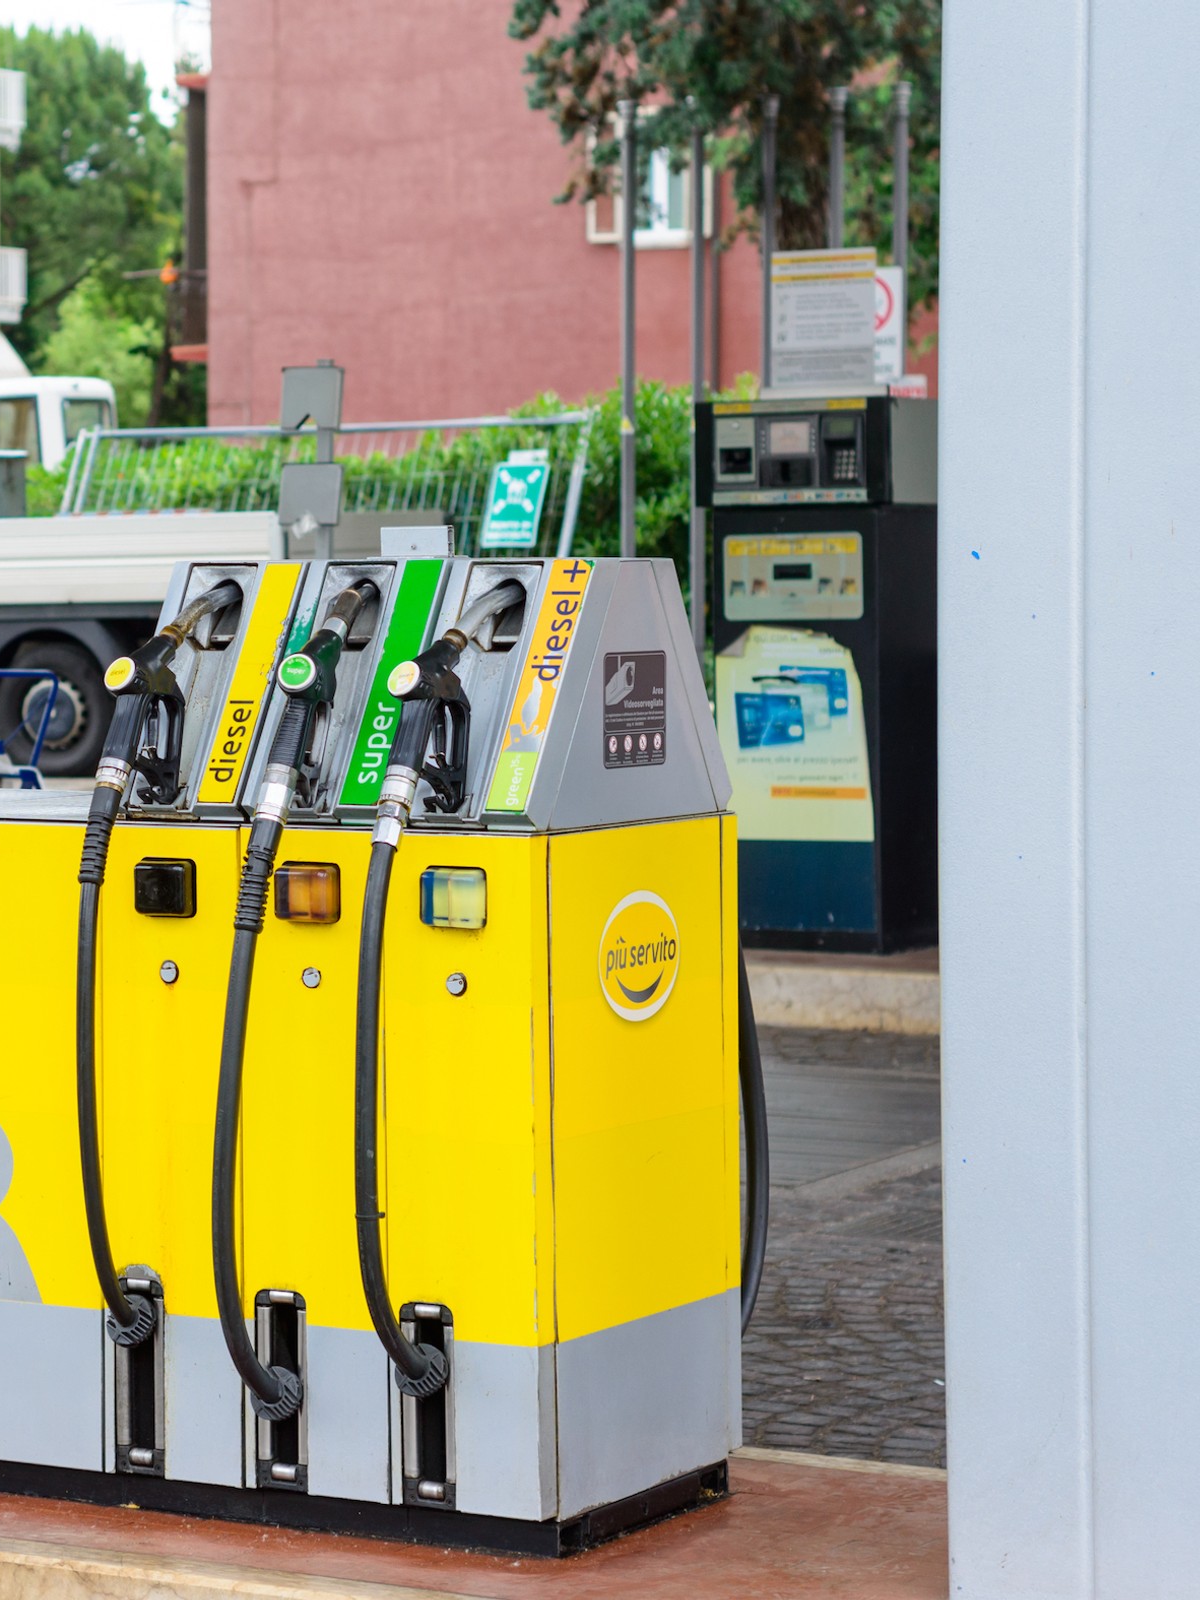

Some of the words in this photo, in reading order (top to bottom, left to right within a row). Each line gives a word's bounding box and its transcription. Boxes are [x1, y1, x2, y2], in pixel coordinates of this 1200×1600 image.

[287, 667, 306, 675] super
[652, 686, 664, 695] Area
[623, 698, 664, 709] Videosorvegliata
[210, 700, 255, 783] diesel
[358, 702, 396, 785] super
[506, 767, 525, 806] green
[605, 935, 627, 980] più
[629, 931, 677, 968] servito
